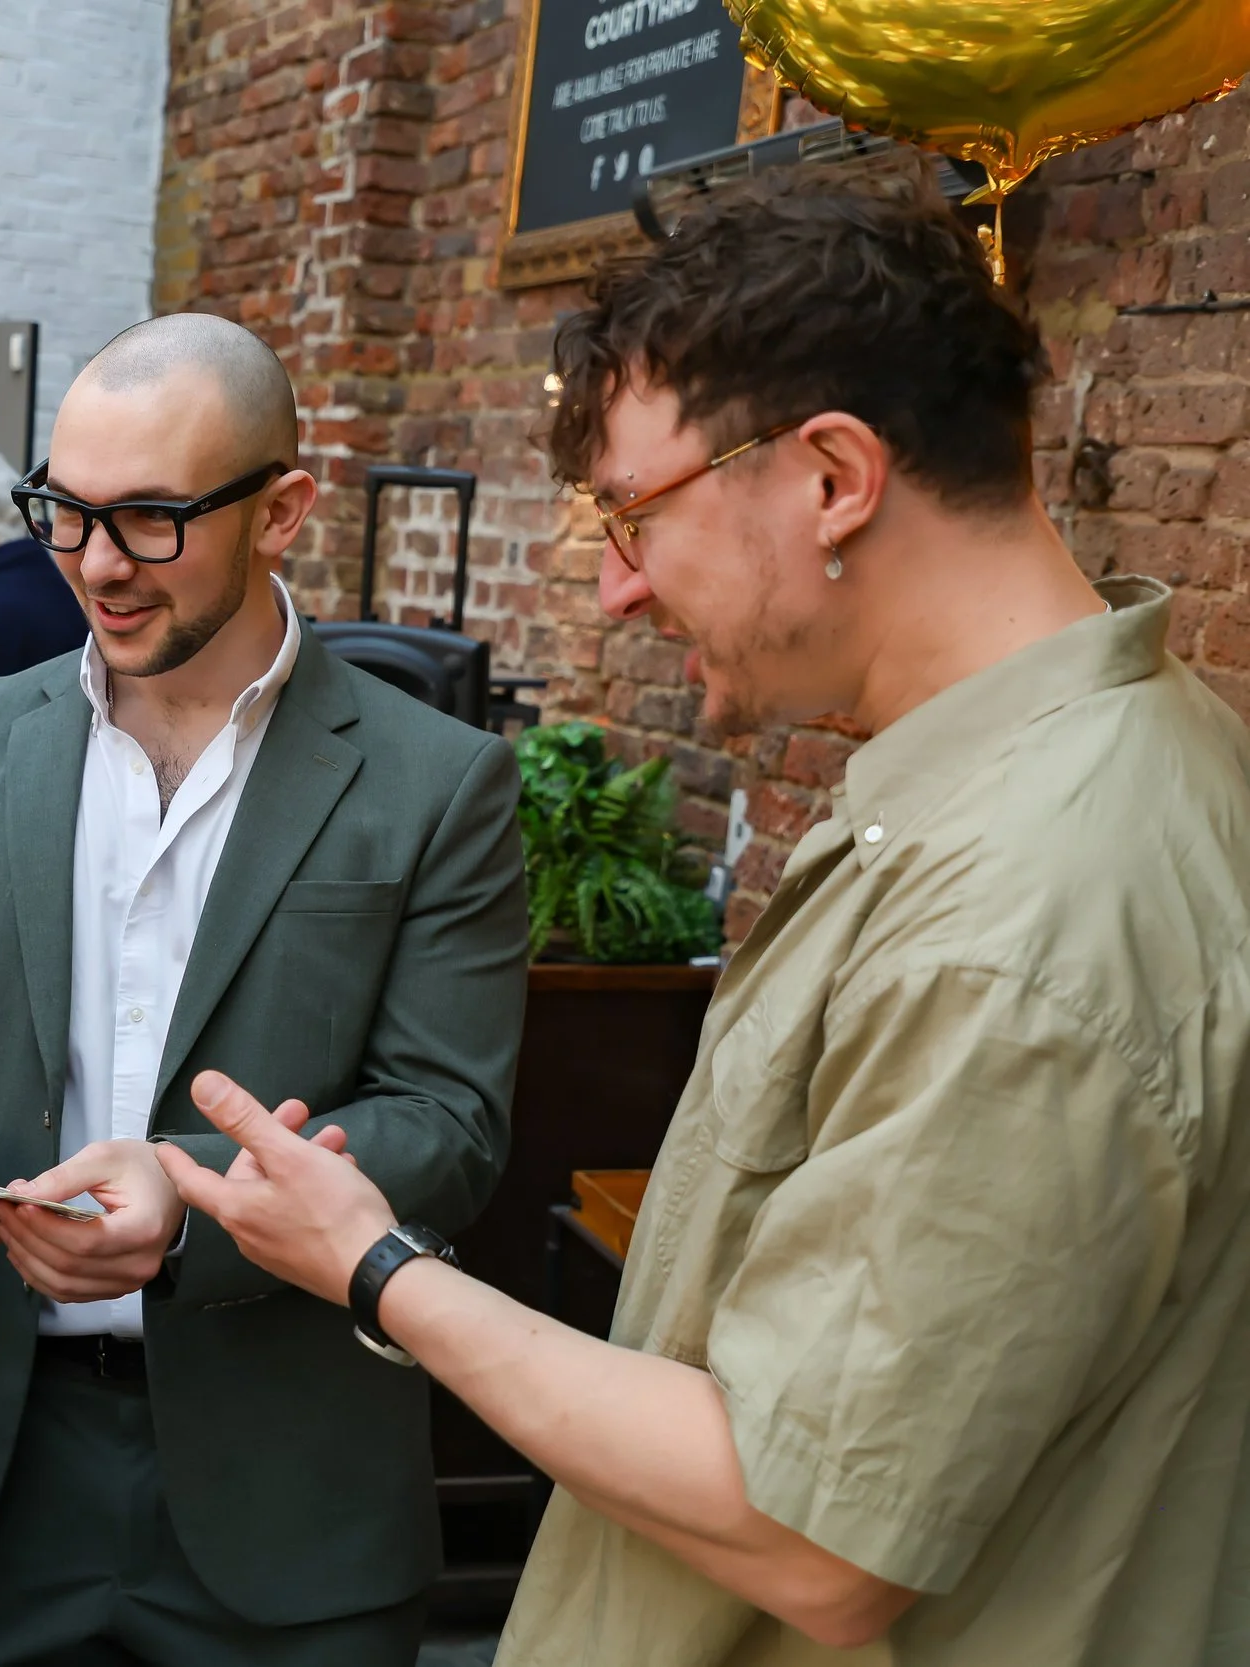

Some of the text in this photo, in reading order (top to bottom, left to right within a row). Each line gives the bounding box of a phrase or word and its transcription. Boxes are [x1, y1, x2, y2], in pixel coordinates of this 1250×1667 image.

[584, 0, 699, 50] COURTYARD
[645, 38, 694, 80] PRIVATE
[692, 29, 722, 64] HIRE
